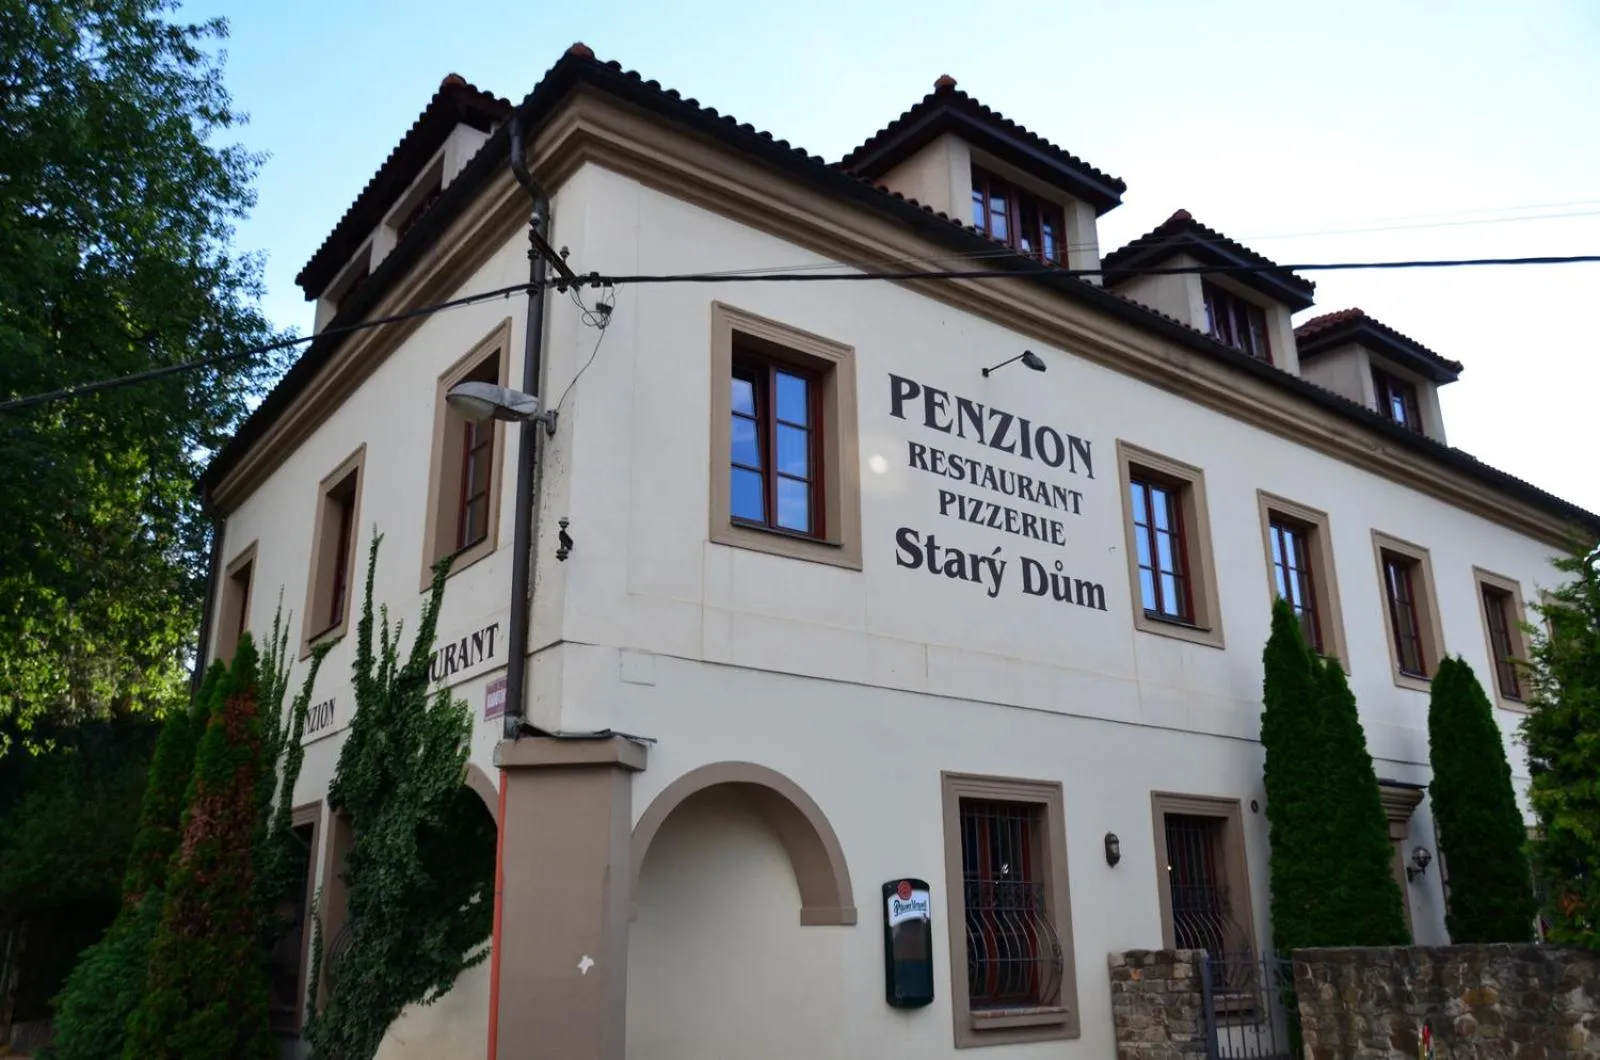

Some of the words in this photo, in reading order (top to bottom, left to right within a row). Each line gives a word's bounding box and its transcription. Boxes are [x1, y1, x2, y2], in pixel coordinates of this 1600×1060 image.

[887, 372, 1095, 480] PENZION
[908, 440, 1083, 515] RESTAURANT
[938, 489, 1066, 547] PIZZERIE
[895, 527, 1008, 599] Starý
[1020, 556, 1109, 612] Dům
[304, 697, 336, 735] NZION
[428, 622, 499, 682] URANT
